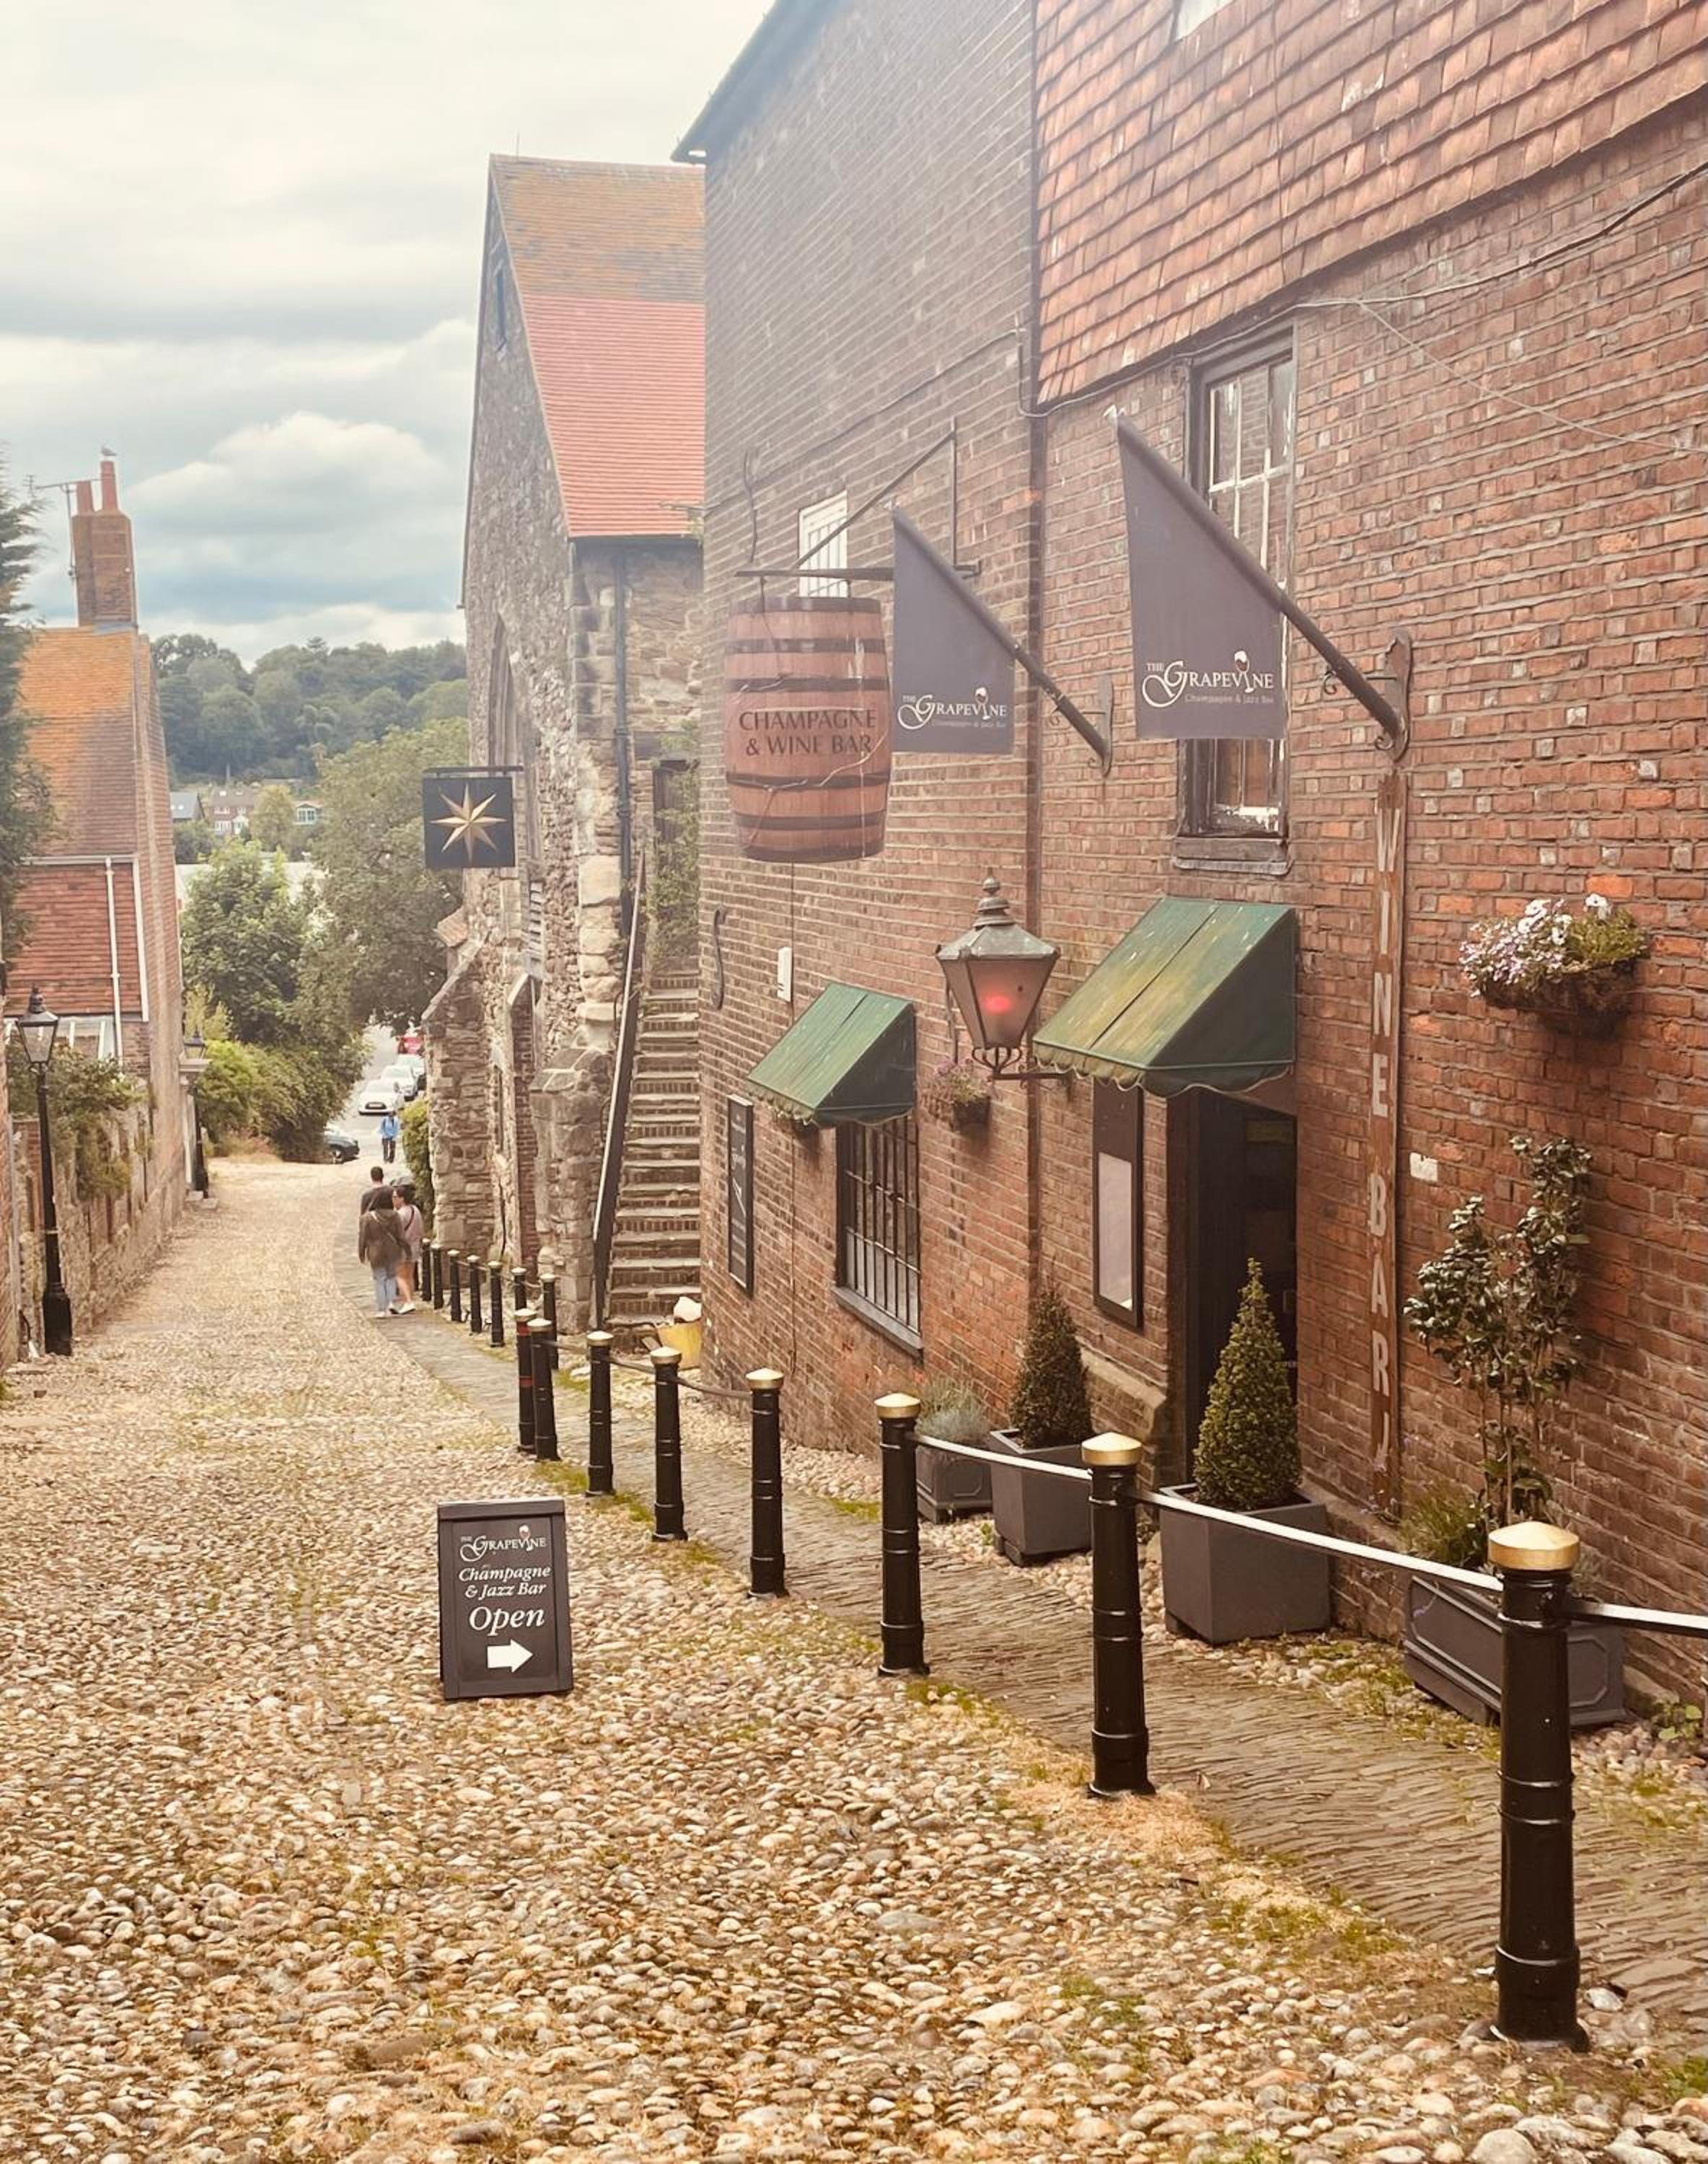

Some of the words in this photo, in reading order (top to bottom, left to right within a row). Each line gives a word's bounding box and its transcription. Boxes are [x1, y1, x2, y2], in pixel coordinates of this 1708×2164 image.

[739, 709, 878, 731] CHAMPAGNE
[746, 737, 760, 757] &
[767, 735, 820, 754] WINE
[831, 734, 873, 754] BAR
[1373, 807, 1401, 1118] WINE
[1370, 1173, 1390, 1398] BAR
[459, 1566, 551, 1583] Champagne
[465, 1585, 477, 1598] &
[477, 1583, 515, 1601] Jazz
[518, 1582, 547, 1596] Bar
[469, 1606, 545, 1637] Open
